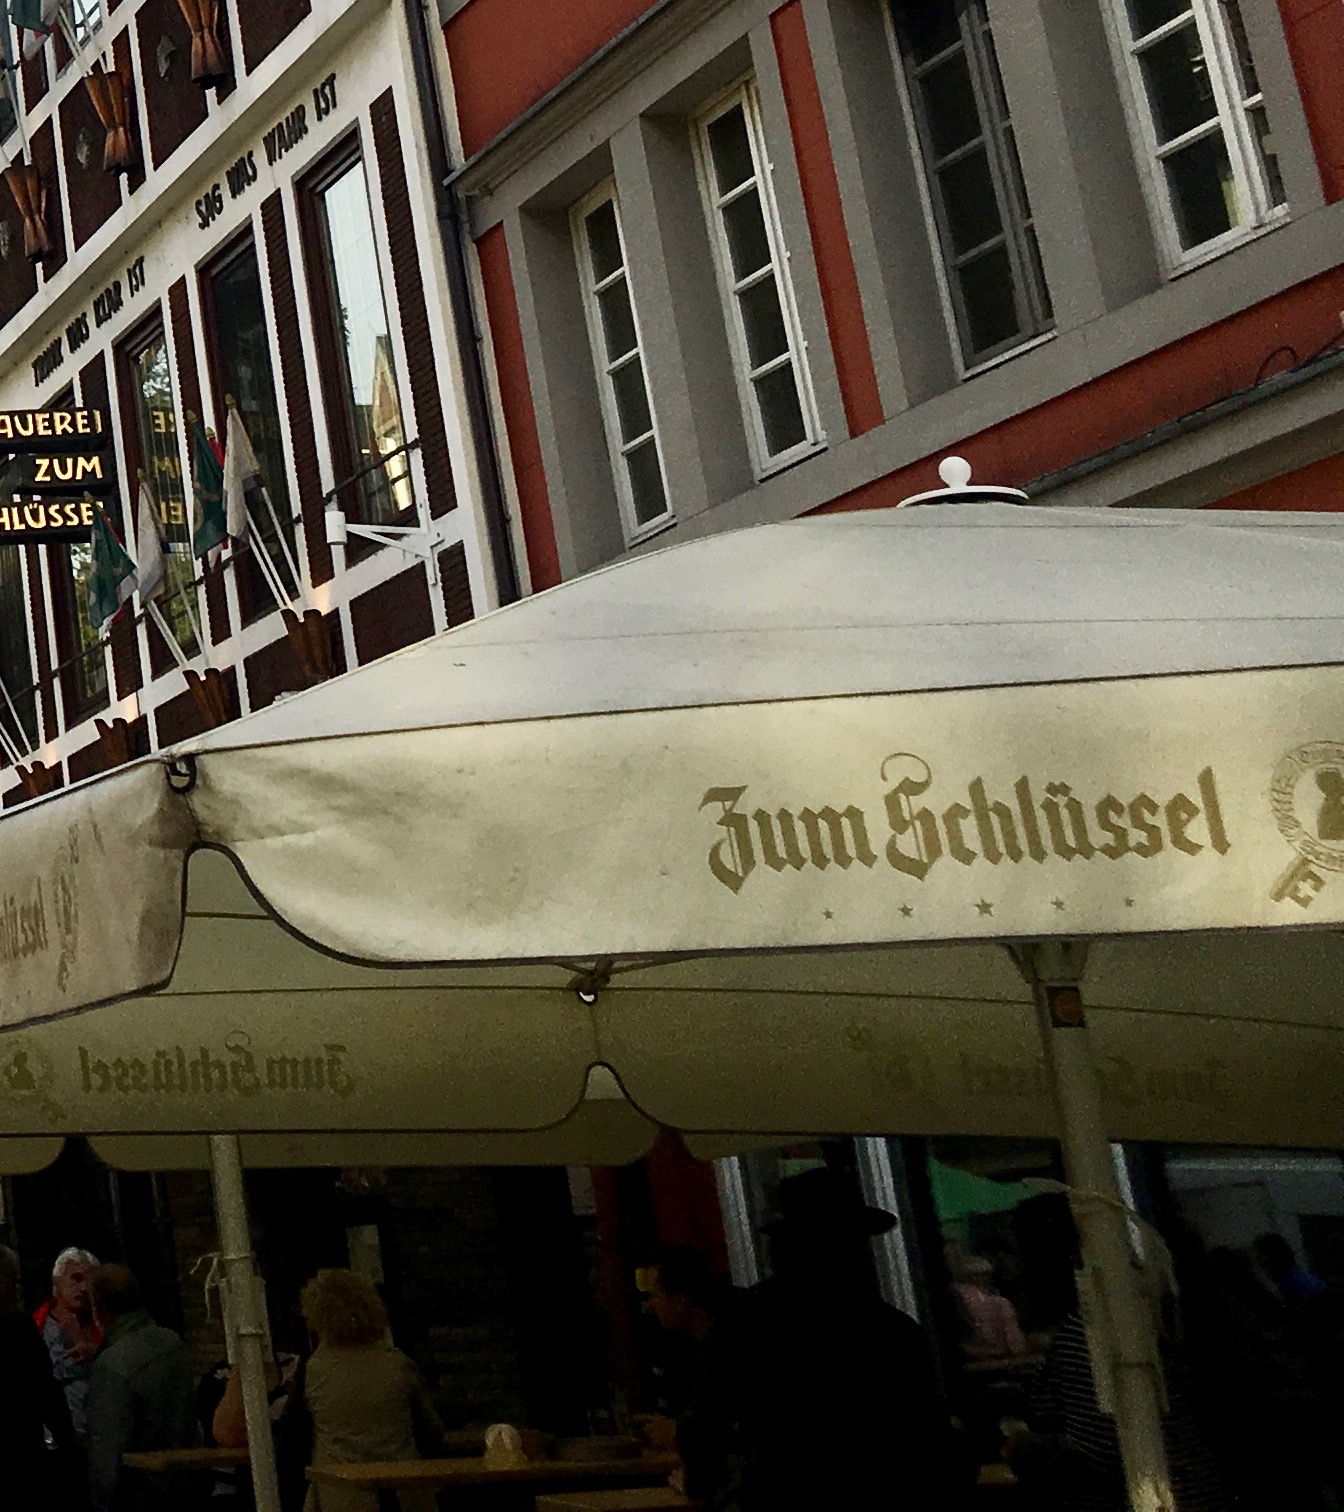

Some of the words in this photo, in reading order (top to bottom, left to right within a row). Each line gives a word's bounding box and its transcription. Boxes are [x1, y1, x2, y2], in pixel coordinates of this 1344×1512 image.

[194, 183, 224, 230] SAG
[225, 149, 258, 199] WAS
[262, 103, 309, 166] WAHR
[312, 72, 338, 122] IST
[126, 255, 146, 298] IST
[34, 455, 104, 482] ZUM
[697, 784, 878, 896] Zum
[880, 752, 1232, 882] Schlüssel
